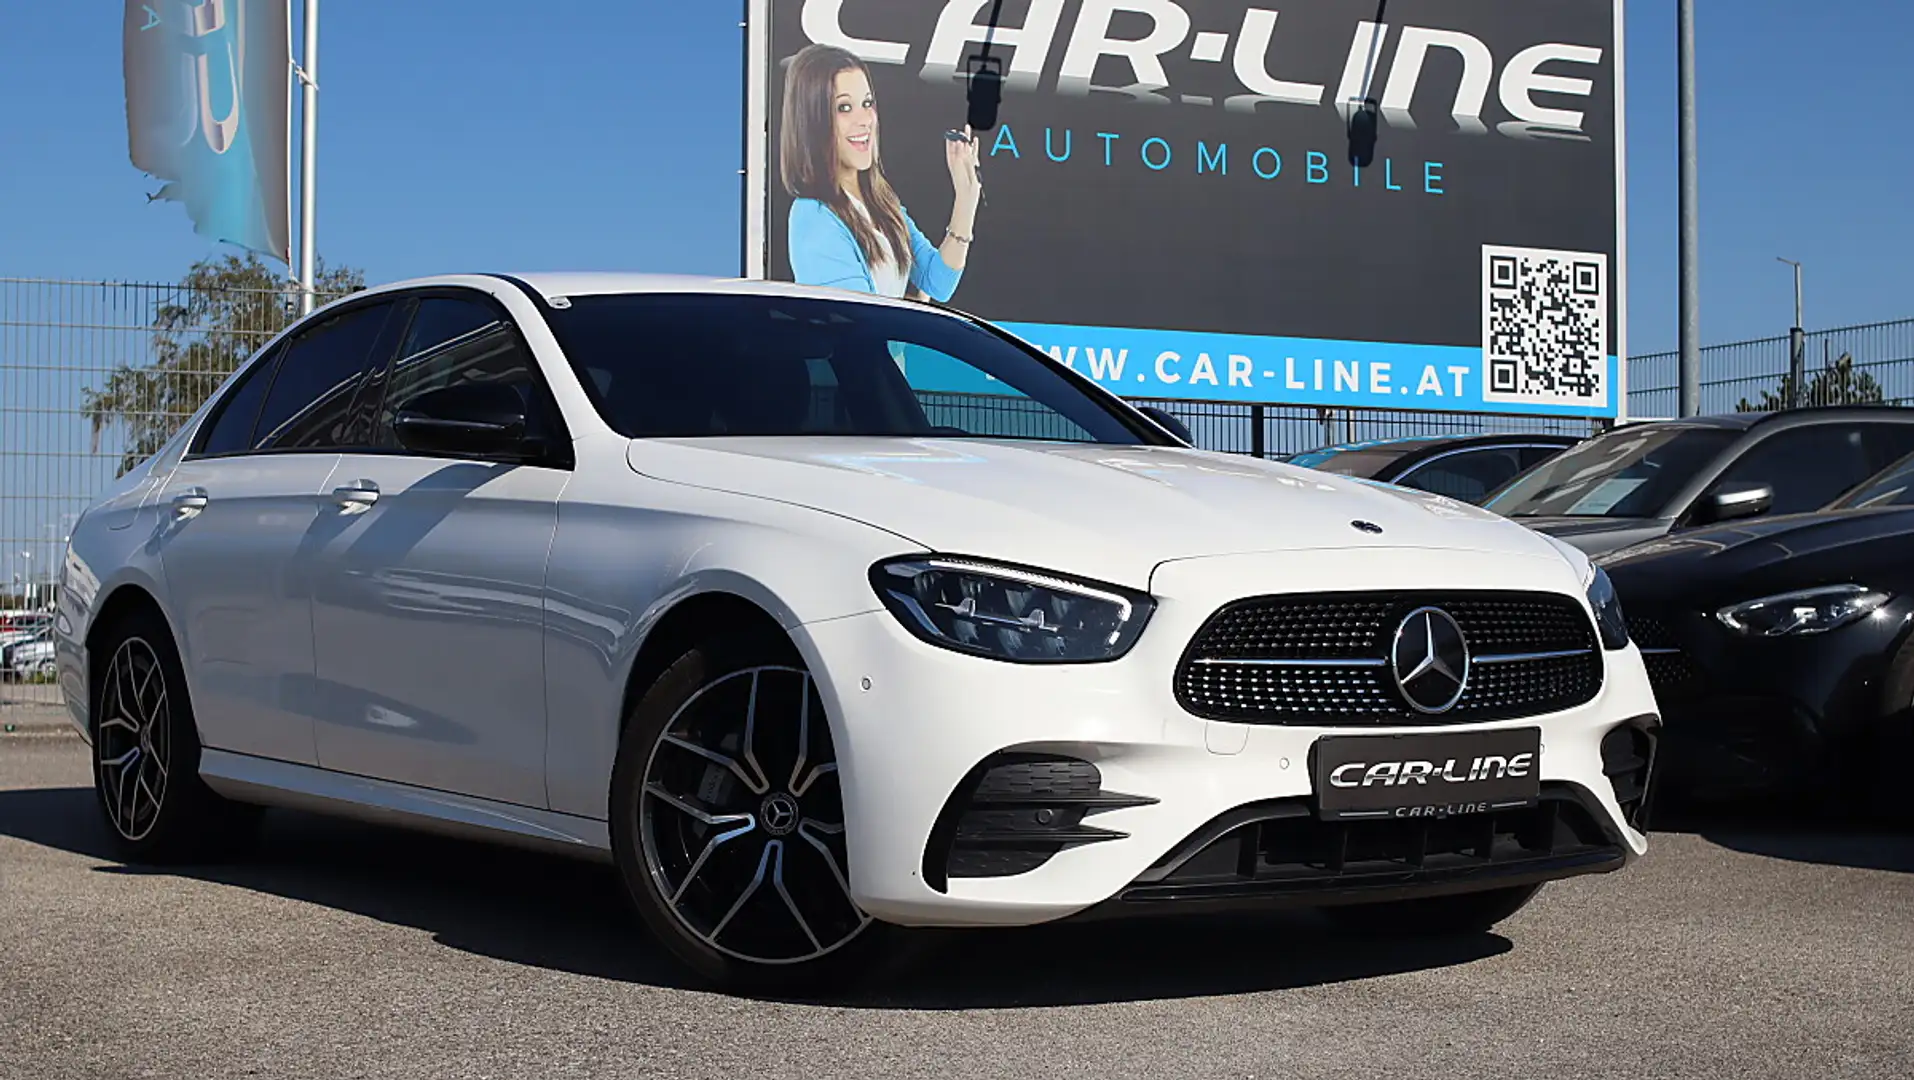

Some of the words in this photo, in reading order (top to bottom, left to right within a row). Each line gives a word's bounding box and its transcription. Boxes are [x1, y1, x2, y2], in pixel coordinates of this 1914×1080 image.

[800, 0, 1603, 129] CAR-LINE
[990, 123, 1444, 194] AUTOMOBILE
[1033, 344, 1470, 397] W.CAR-LINE.AT
[1330, 752, 1533, 787] CAR-LINE
[1395, 802, 1487, 817] CAR-LINE
